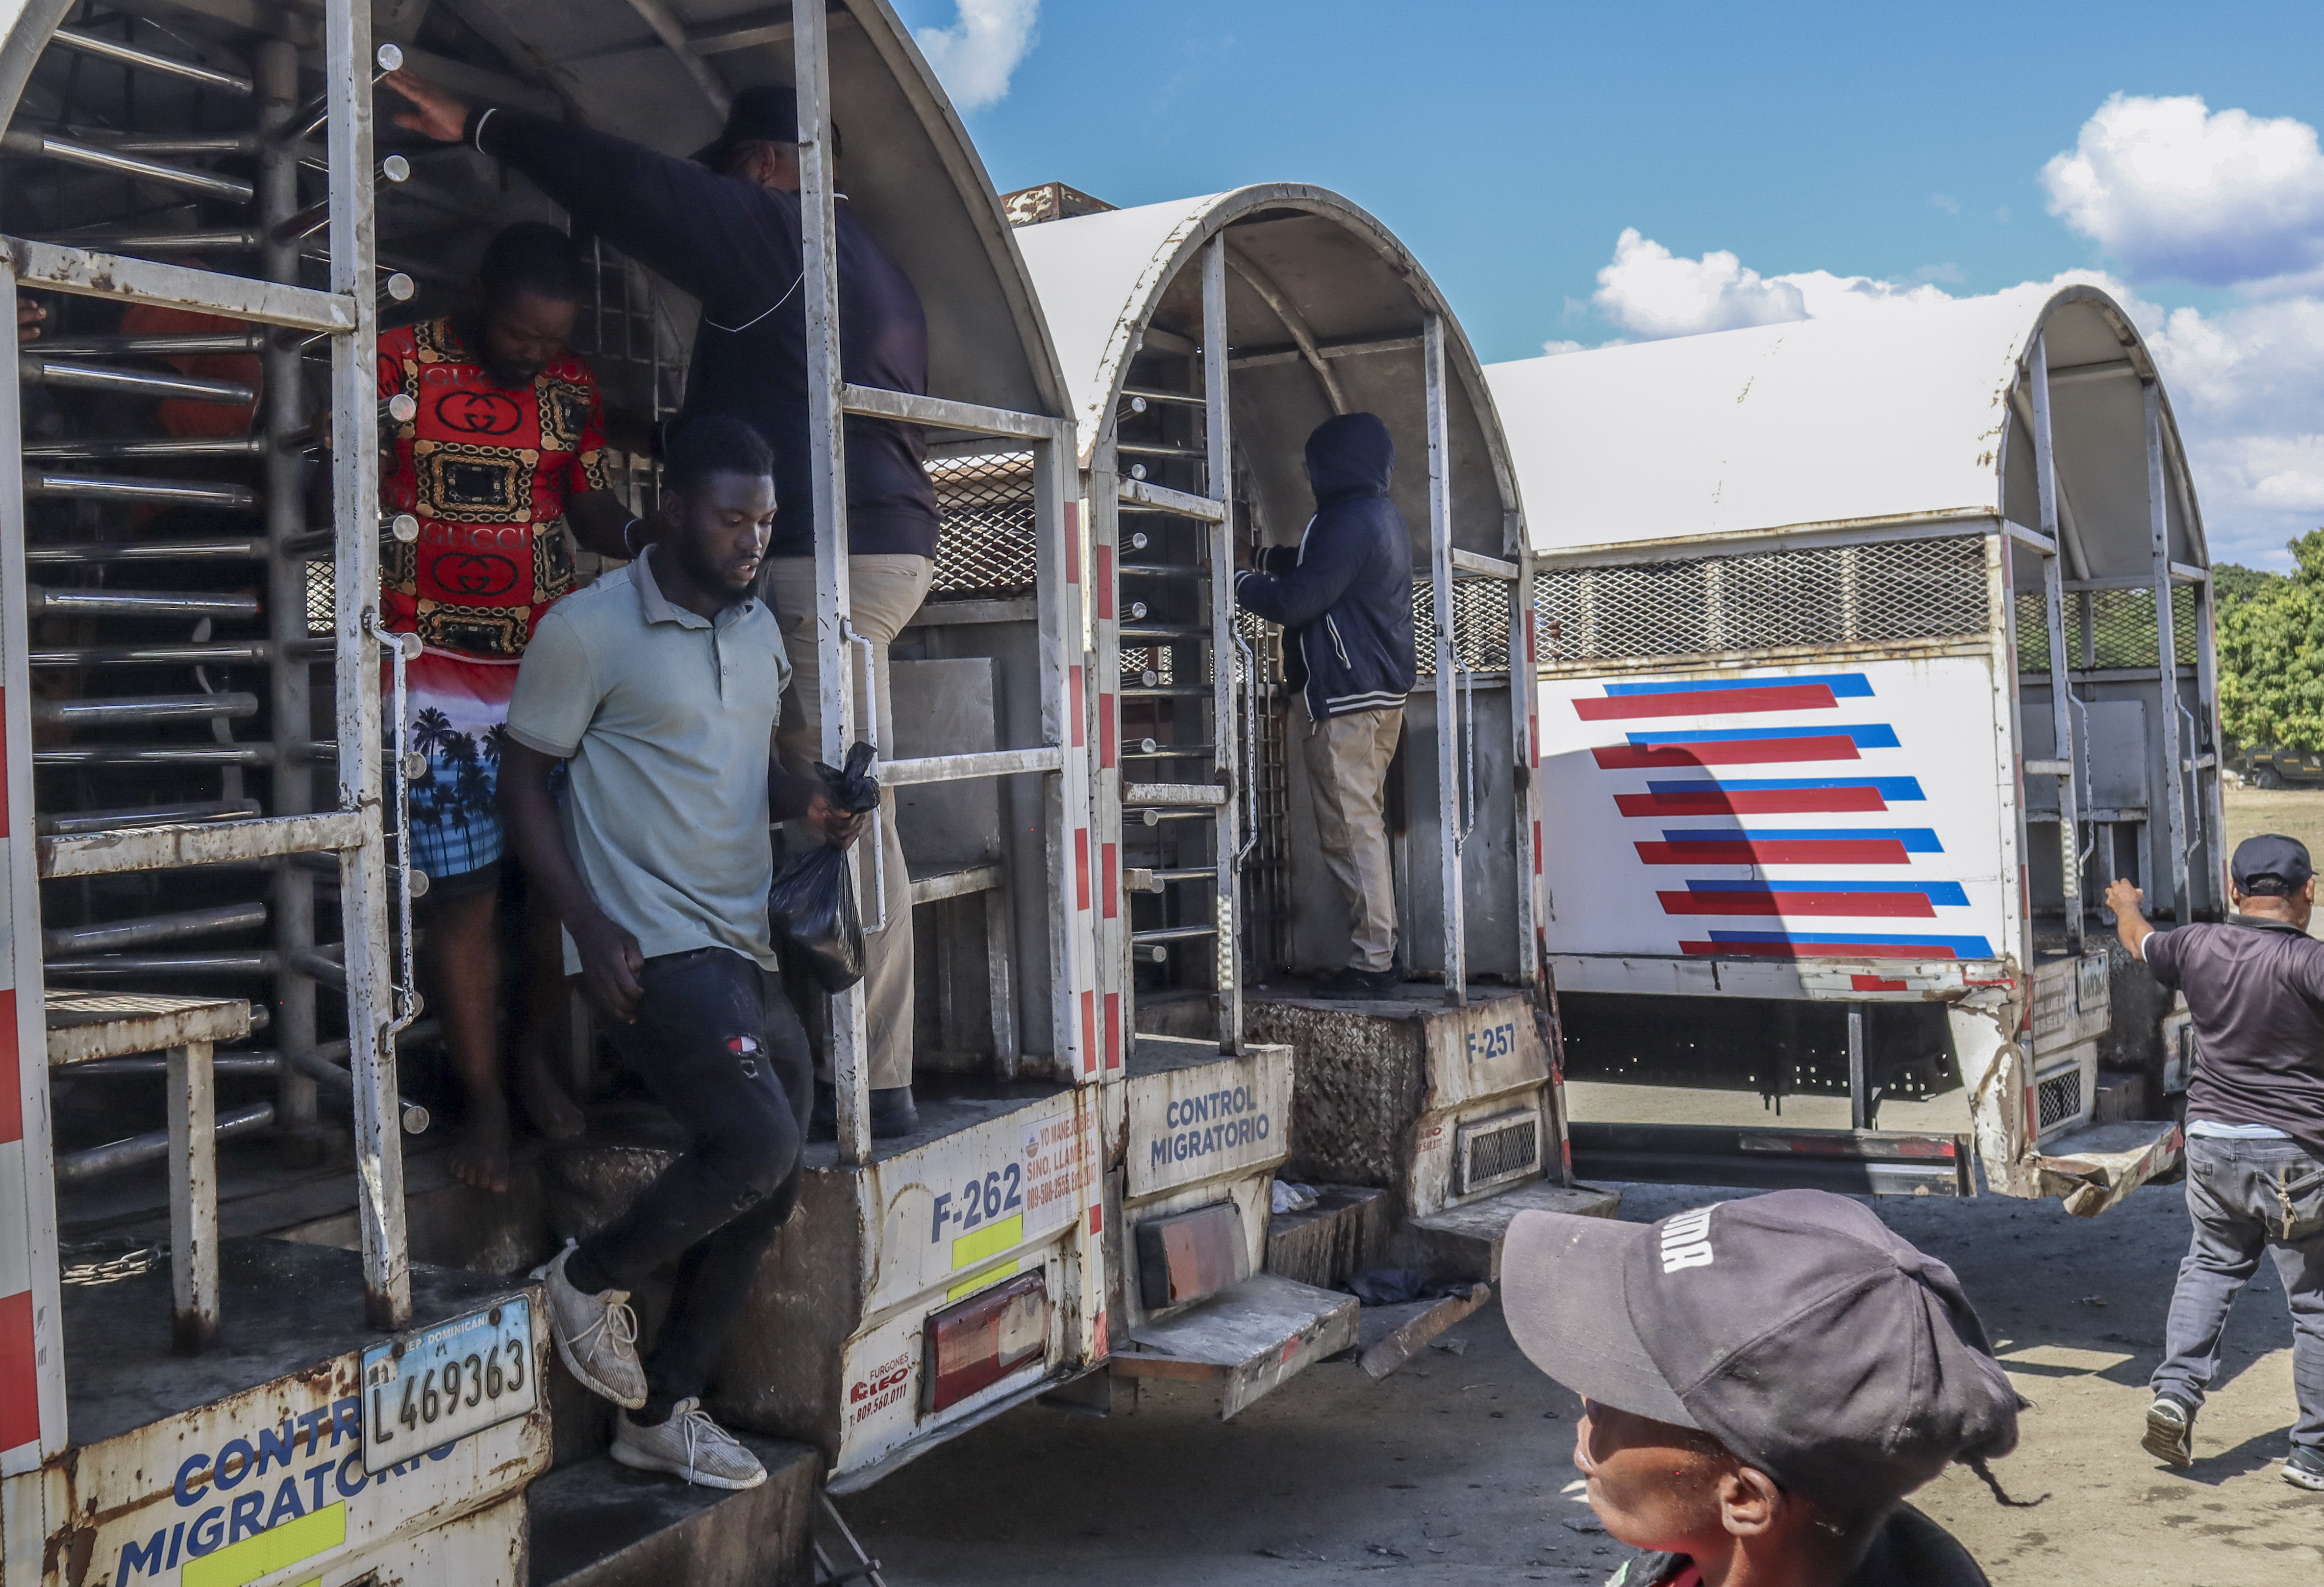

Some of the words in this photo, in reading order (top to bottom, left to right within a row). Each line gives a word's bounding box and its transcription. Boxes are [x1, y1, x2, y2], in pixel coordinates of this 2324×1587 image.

[425, 368, 493, 388] GUC
[423, 522, 526, 549] GUCCI
[1467, 1022, 1515, 1064] F-257
[1040, 1127, 1050, 1148] YO
[1051, 1116, 1078, 1144] MANEJO
[1079, 1109, 1095, 1133] BIEN
[1166, 1085, 1257, 1129] CONTROL
[1026, 1155, 1051, 1182] SINO,
[1054, 1142, 1082, 1171] LLAME
[1085, 1138, 1095, 1159] AL
[1151, 1113, 1269, 1168] MIGRATORIO
[931, 1163, 1021, 1244] F-262
[870, 1352, 908, 1381] FURGONES
[374, 1339, 524, 1444] L469363
[850, 1414, 855, 1427] T:
[856, 1382, 907, 1423] 809.560.0111
[174, 1396, 362, 1507] CONTR
